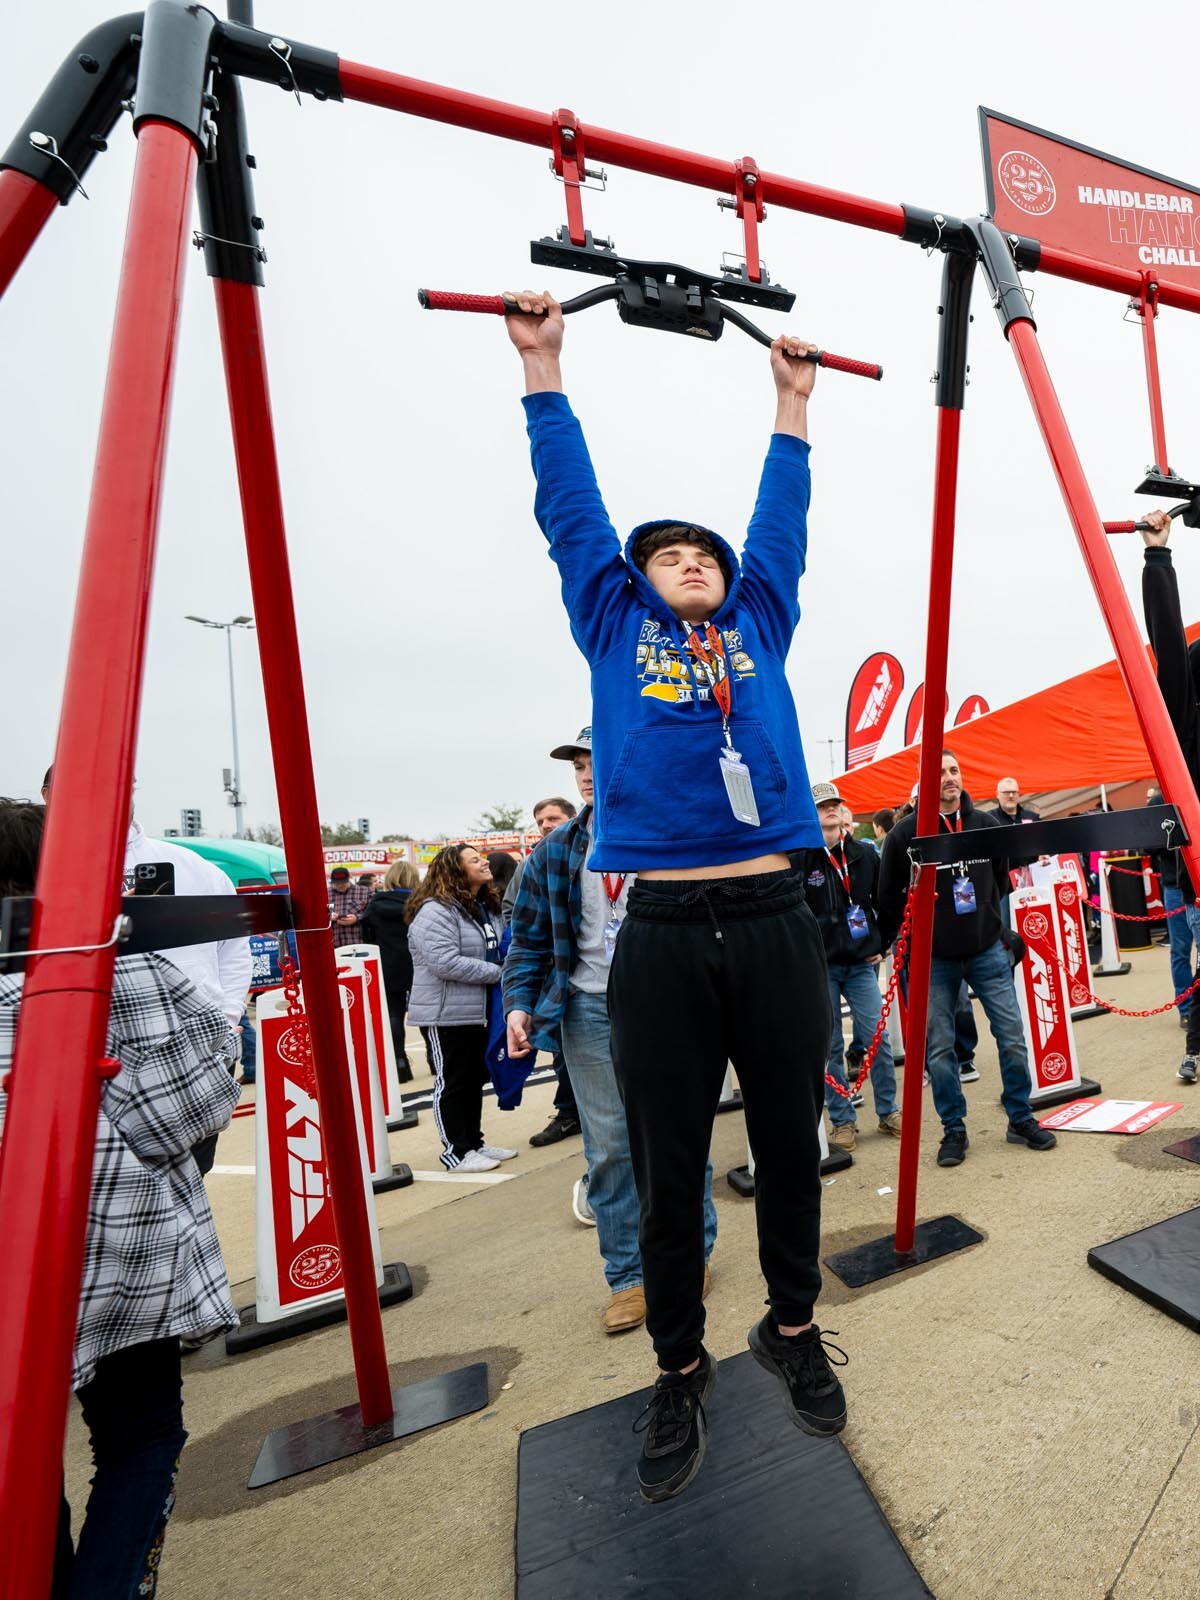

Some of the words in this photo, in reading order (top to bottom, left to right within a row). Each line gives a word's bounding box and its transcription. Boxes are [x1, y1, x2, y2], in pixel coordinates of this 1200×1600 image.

[1010, 163, 1044, 196] 25
[1077, 185, 1194, 214] HANDLEBAR
[854, 659, 891, 734] FLY
[324, 850, 385, 863] CORNDOGS
[1028, 946, 1055, 1050] FLY
[1047, 963, 1060, 1024] RACING
[283, 1076, 325, 1243] FLY
[301, 1253, 333, 1277] 25
